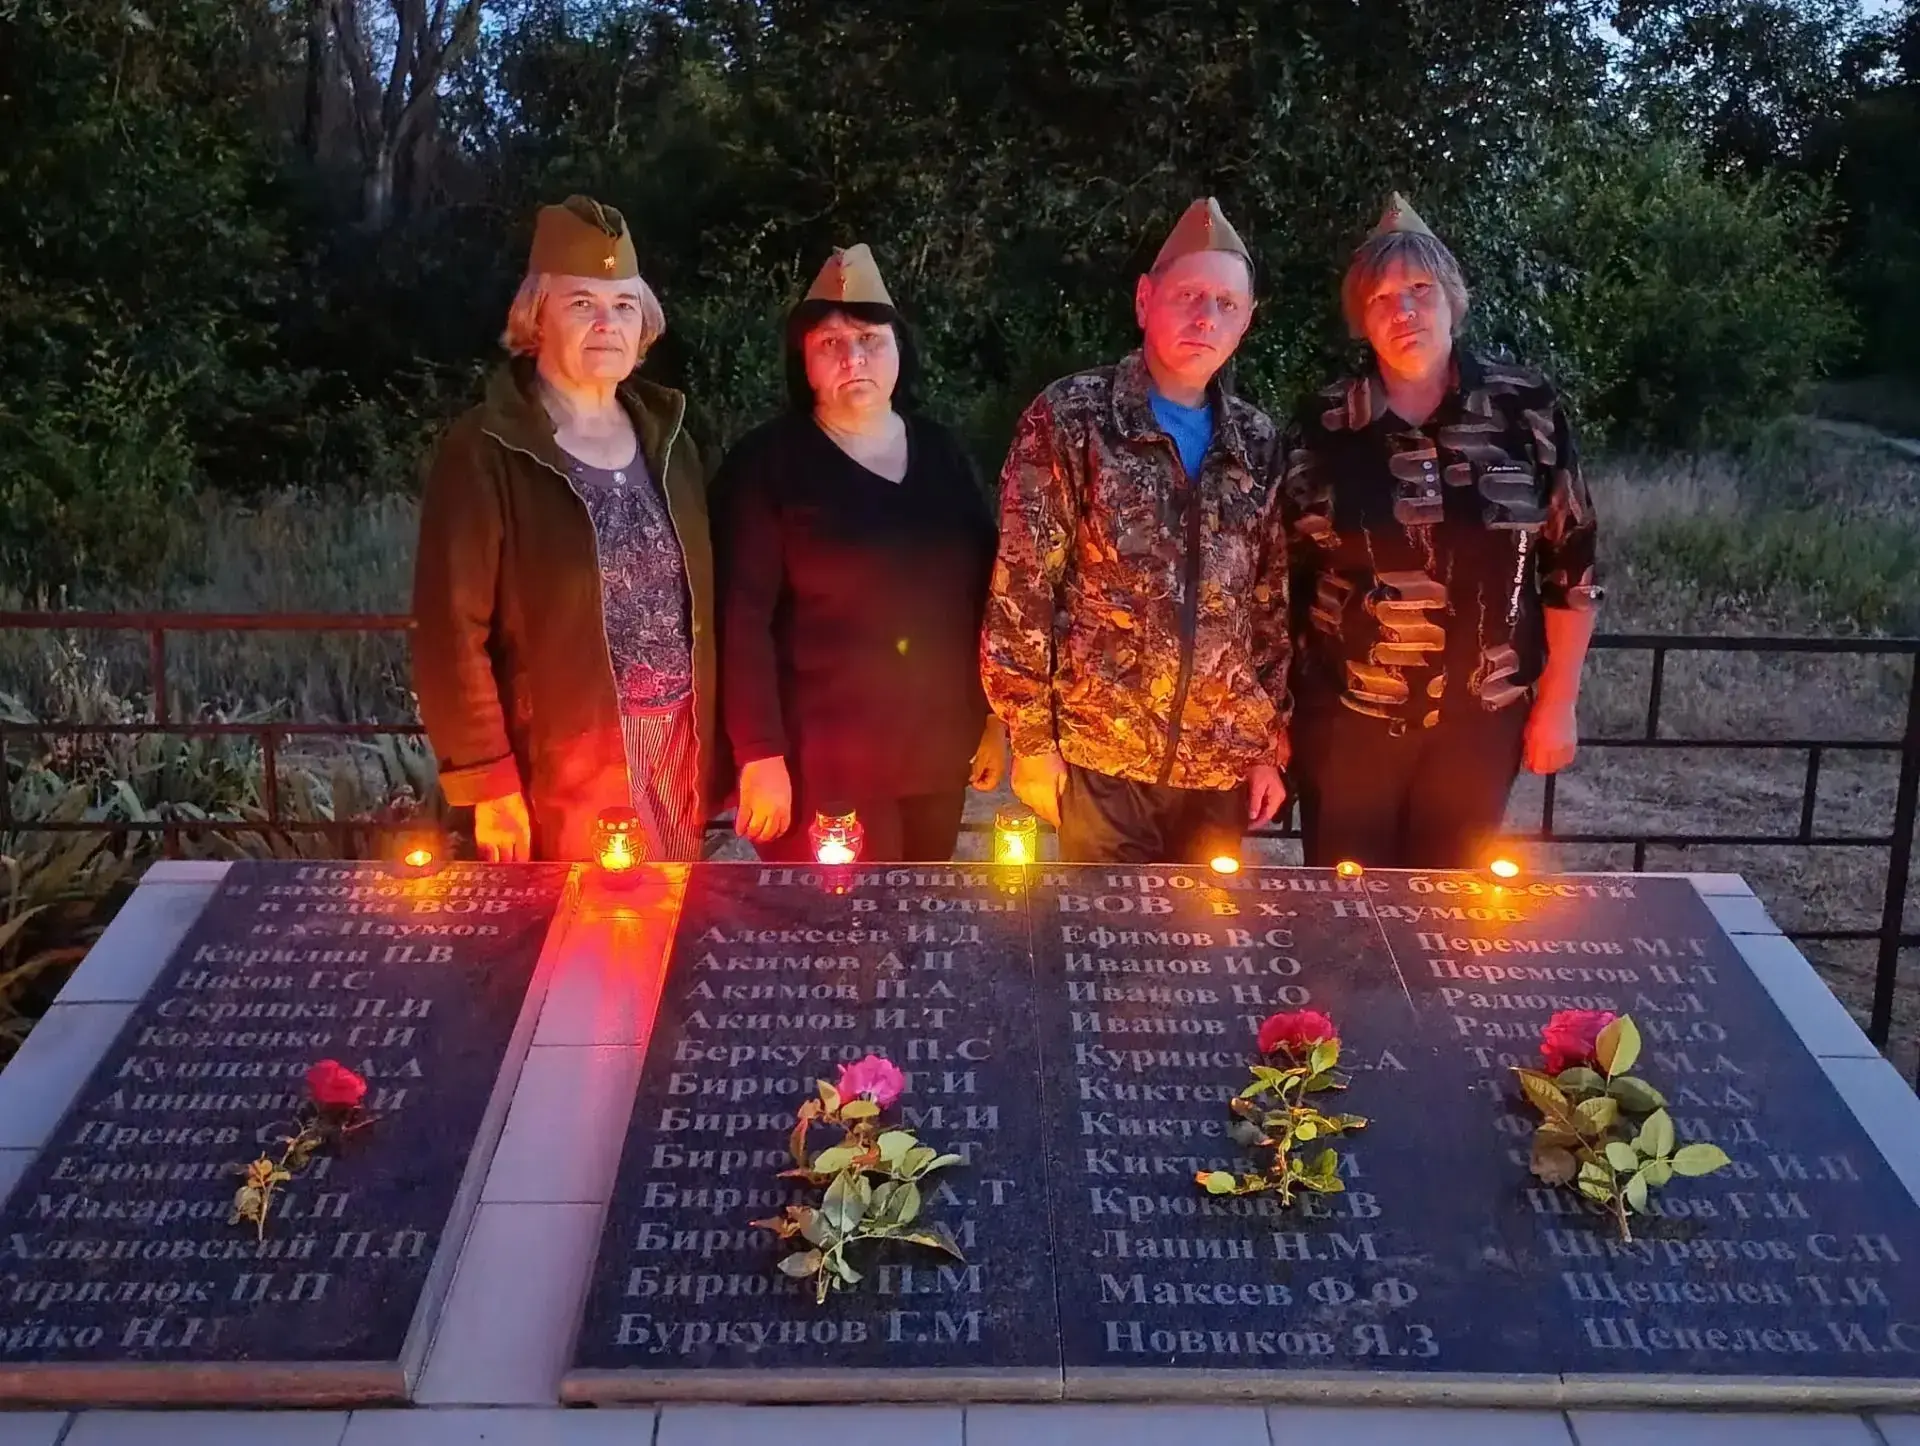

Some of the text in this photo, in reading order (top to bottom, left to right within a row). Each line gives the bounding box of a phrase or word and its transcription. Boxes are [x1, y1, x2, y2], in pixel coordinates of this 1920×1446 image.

[411, 899, 513, 914] ВОВ
[1057, 894, 1175, 915] ВОВ
[1211, 901, 1241, 917] в
[1332, 898, 1528, 924] Наумов
[336, 921, 500, 940] Наумов
[697, 924, 984, 946] Алексеев И.Д
[1060, 924, 1296, 949] Ефимов В.С
[1415, 931, 1626, 958] Переметов
[692, 951, 861, 972] Акимов
[1064, 952, 1302, 977] Иванов И.О
[1424, 959, 1641, 986] Переметов
[685, 979, 859, 1000] Акимов
[1066, 981, 1220, 1004] Иванов
[681, 1007, 956, 1031] Акимов И.Т
[1069, 1011, 1227, 1036] Иванов
[1080, 1110, 1224, 1138] Кикте
[1091, 1228, 1382, 1262] Лапин Н.М
[1098, 1273, 1294, 1307] Макеев
[614, 1310, 985, 1354] Буркунов Г.М
[1102, 1320, 1441, 1360] Новиков Я.З
